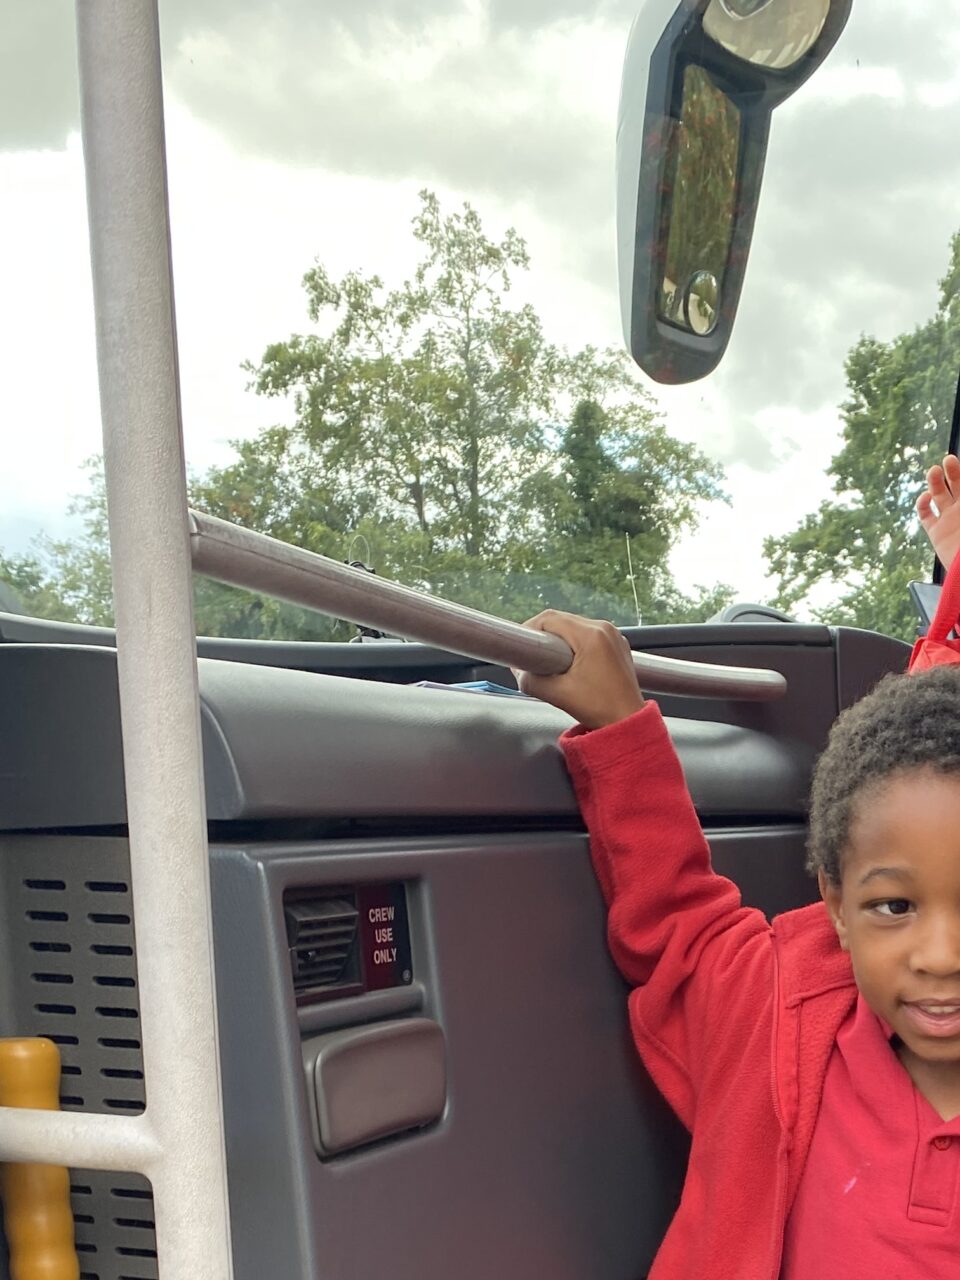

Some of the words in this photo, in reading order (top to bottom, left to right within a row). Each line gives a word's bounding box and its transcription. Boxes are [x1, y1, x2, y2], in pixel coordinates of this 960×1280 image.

[369, 906, 395, 923] CREW
[375, 928, 393, 943] USE
[373, 948, 397, 964] ONLY
